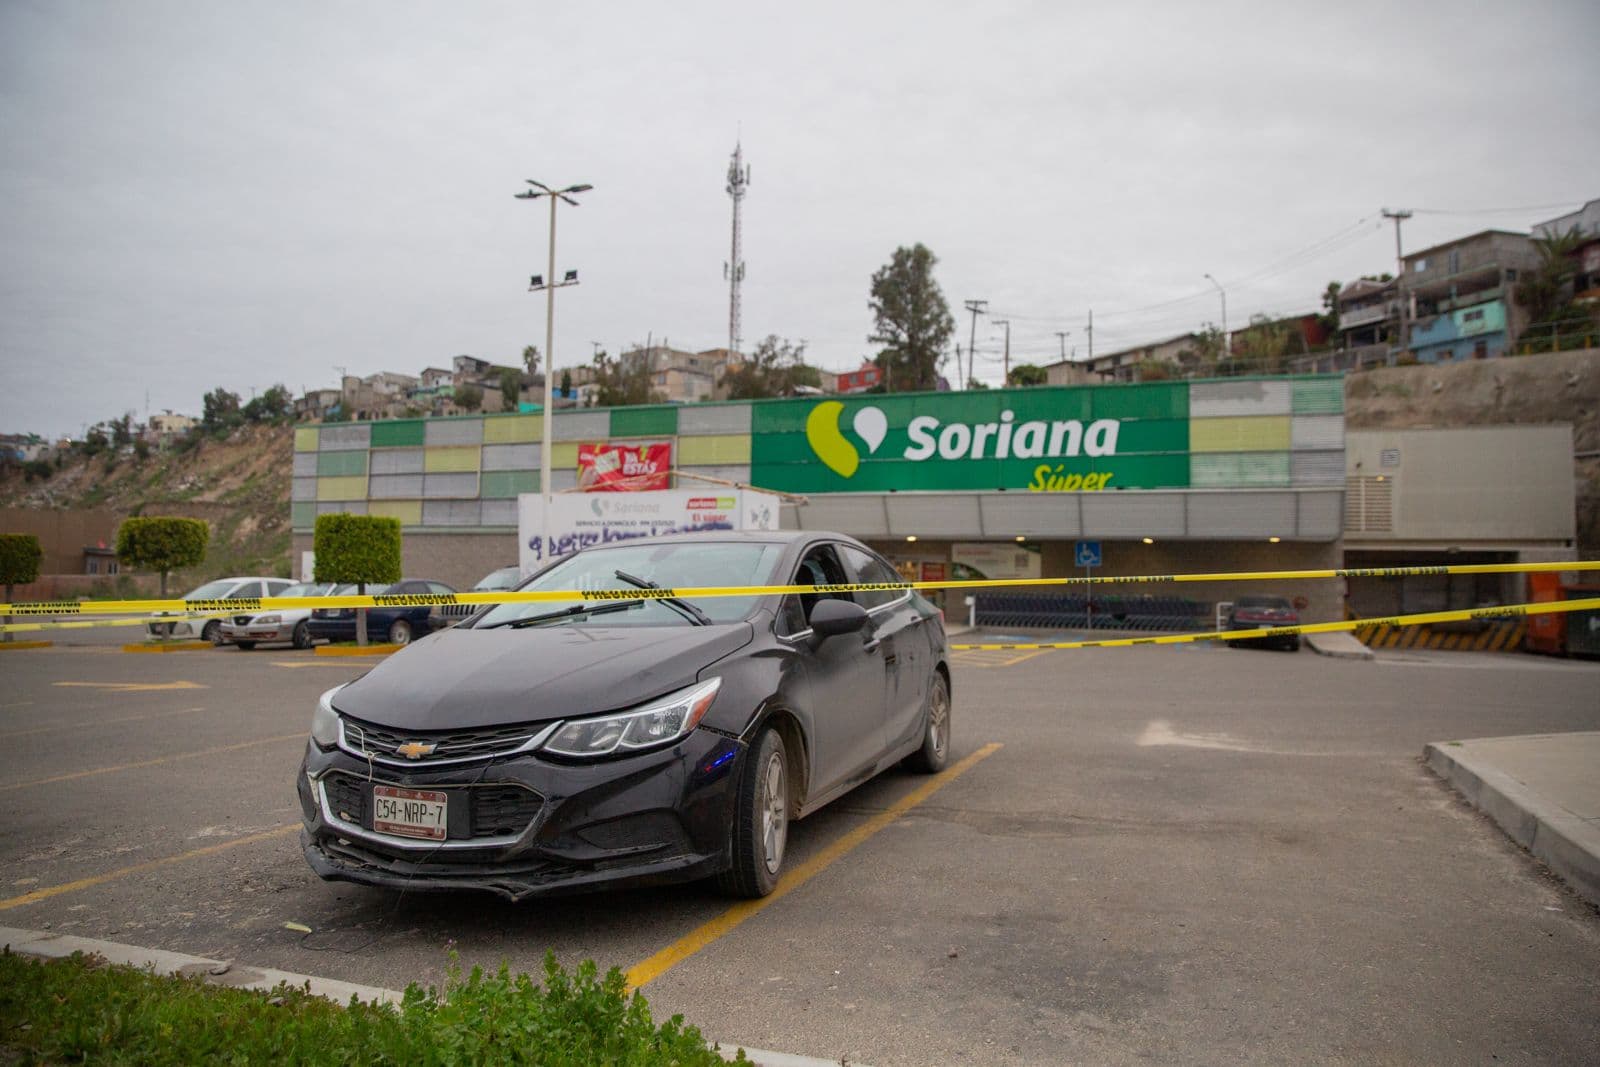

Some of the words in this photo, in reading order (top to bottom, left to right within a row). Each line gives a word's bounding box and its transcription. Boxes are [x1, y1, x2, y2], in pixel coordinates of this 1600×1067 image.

[903, 410, 1120, 461] Soriana
[1028, 464, 1113, 492] Súper
[376, 799, 443, 825] C54-NRP-7
